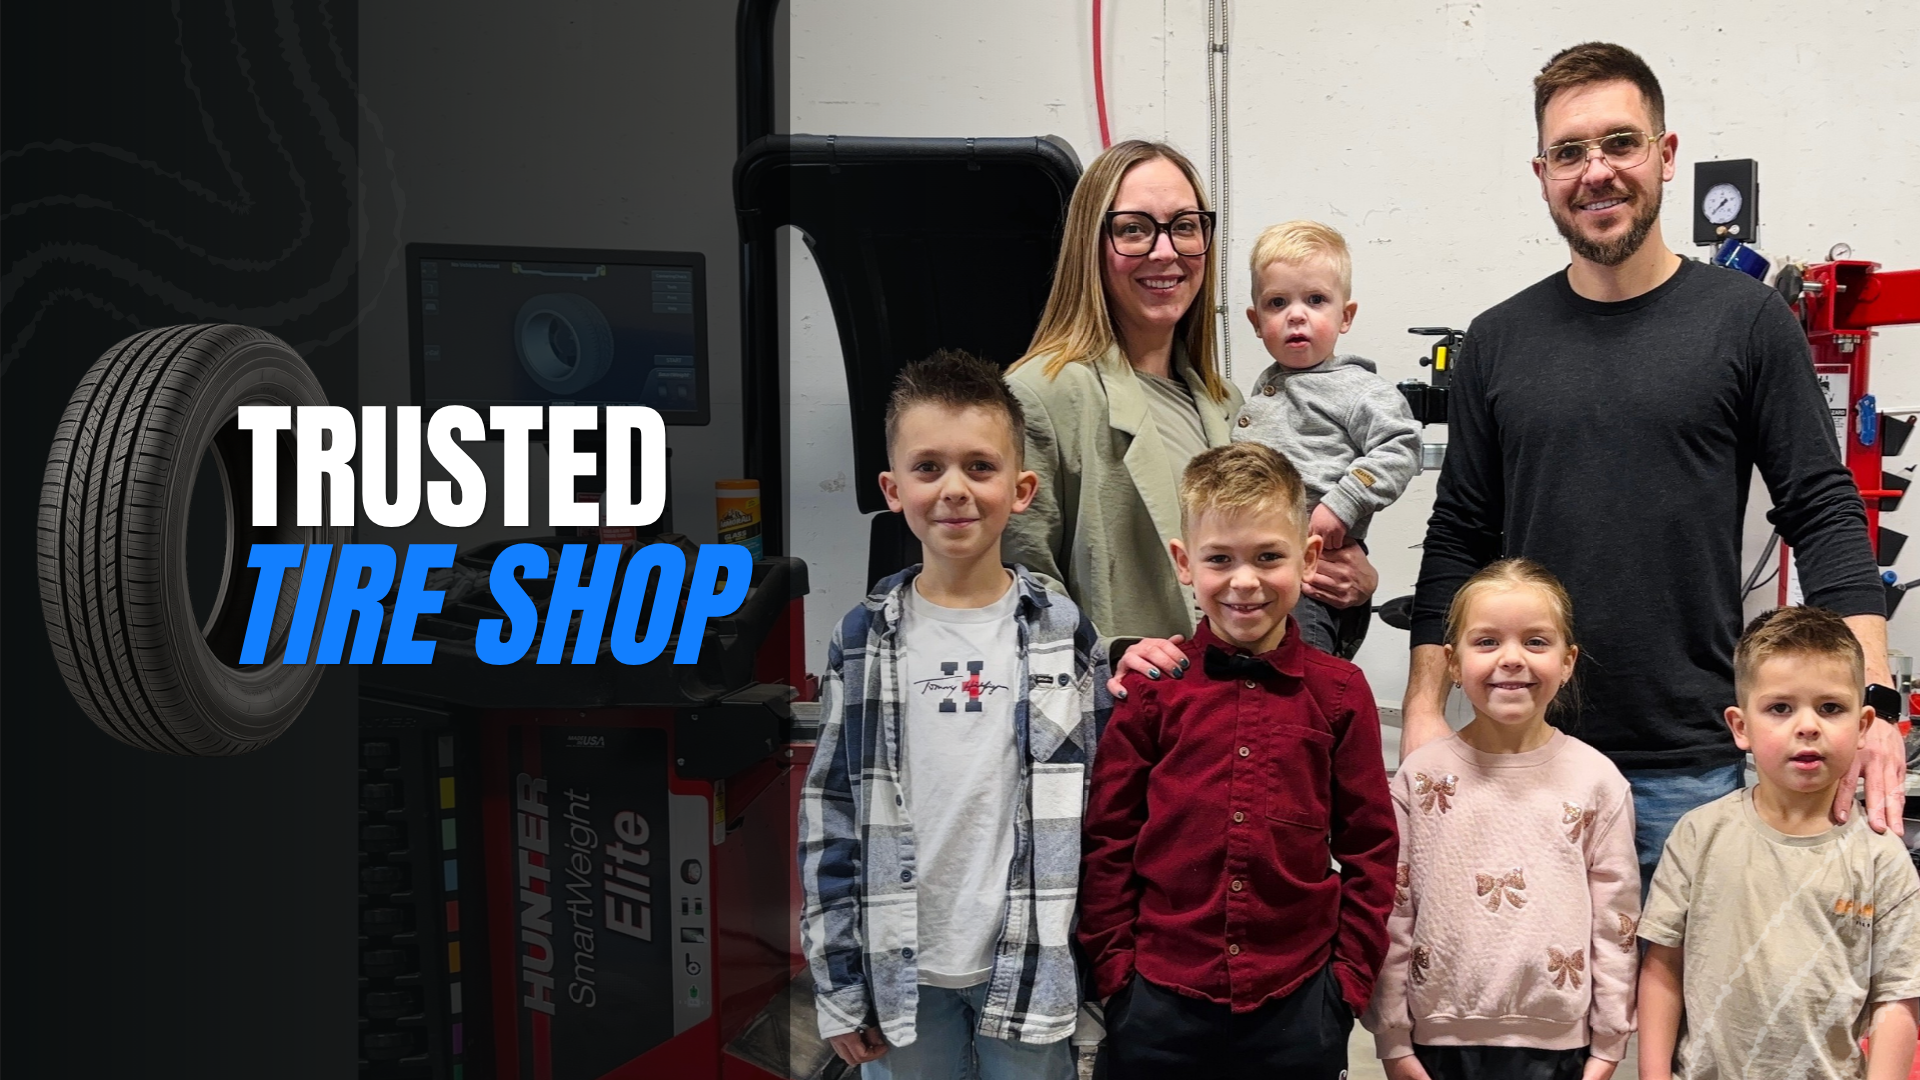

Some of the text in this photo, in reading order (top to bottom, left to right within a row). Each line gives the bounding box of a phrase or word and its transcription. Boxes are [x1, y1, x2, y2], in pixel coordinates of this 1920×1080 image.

[724, 530, 747, 540] GLASS
[914, 675, 963, 697] Tommy
[583, 735, 605, 746] USA
[516, 772, 556, 1016] HUNTER
[563, 788, 598, 1008] SmartWeight
[604, 810, 652, 942] Elite
